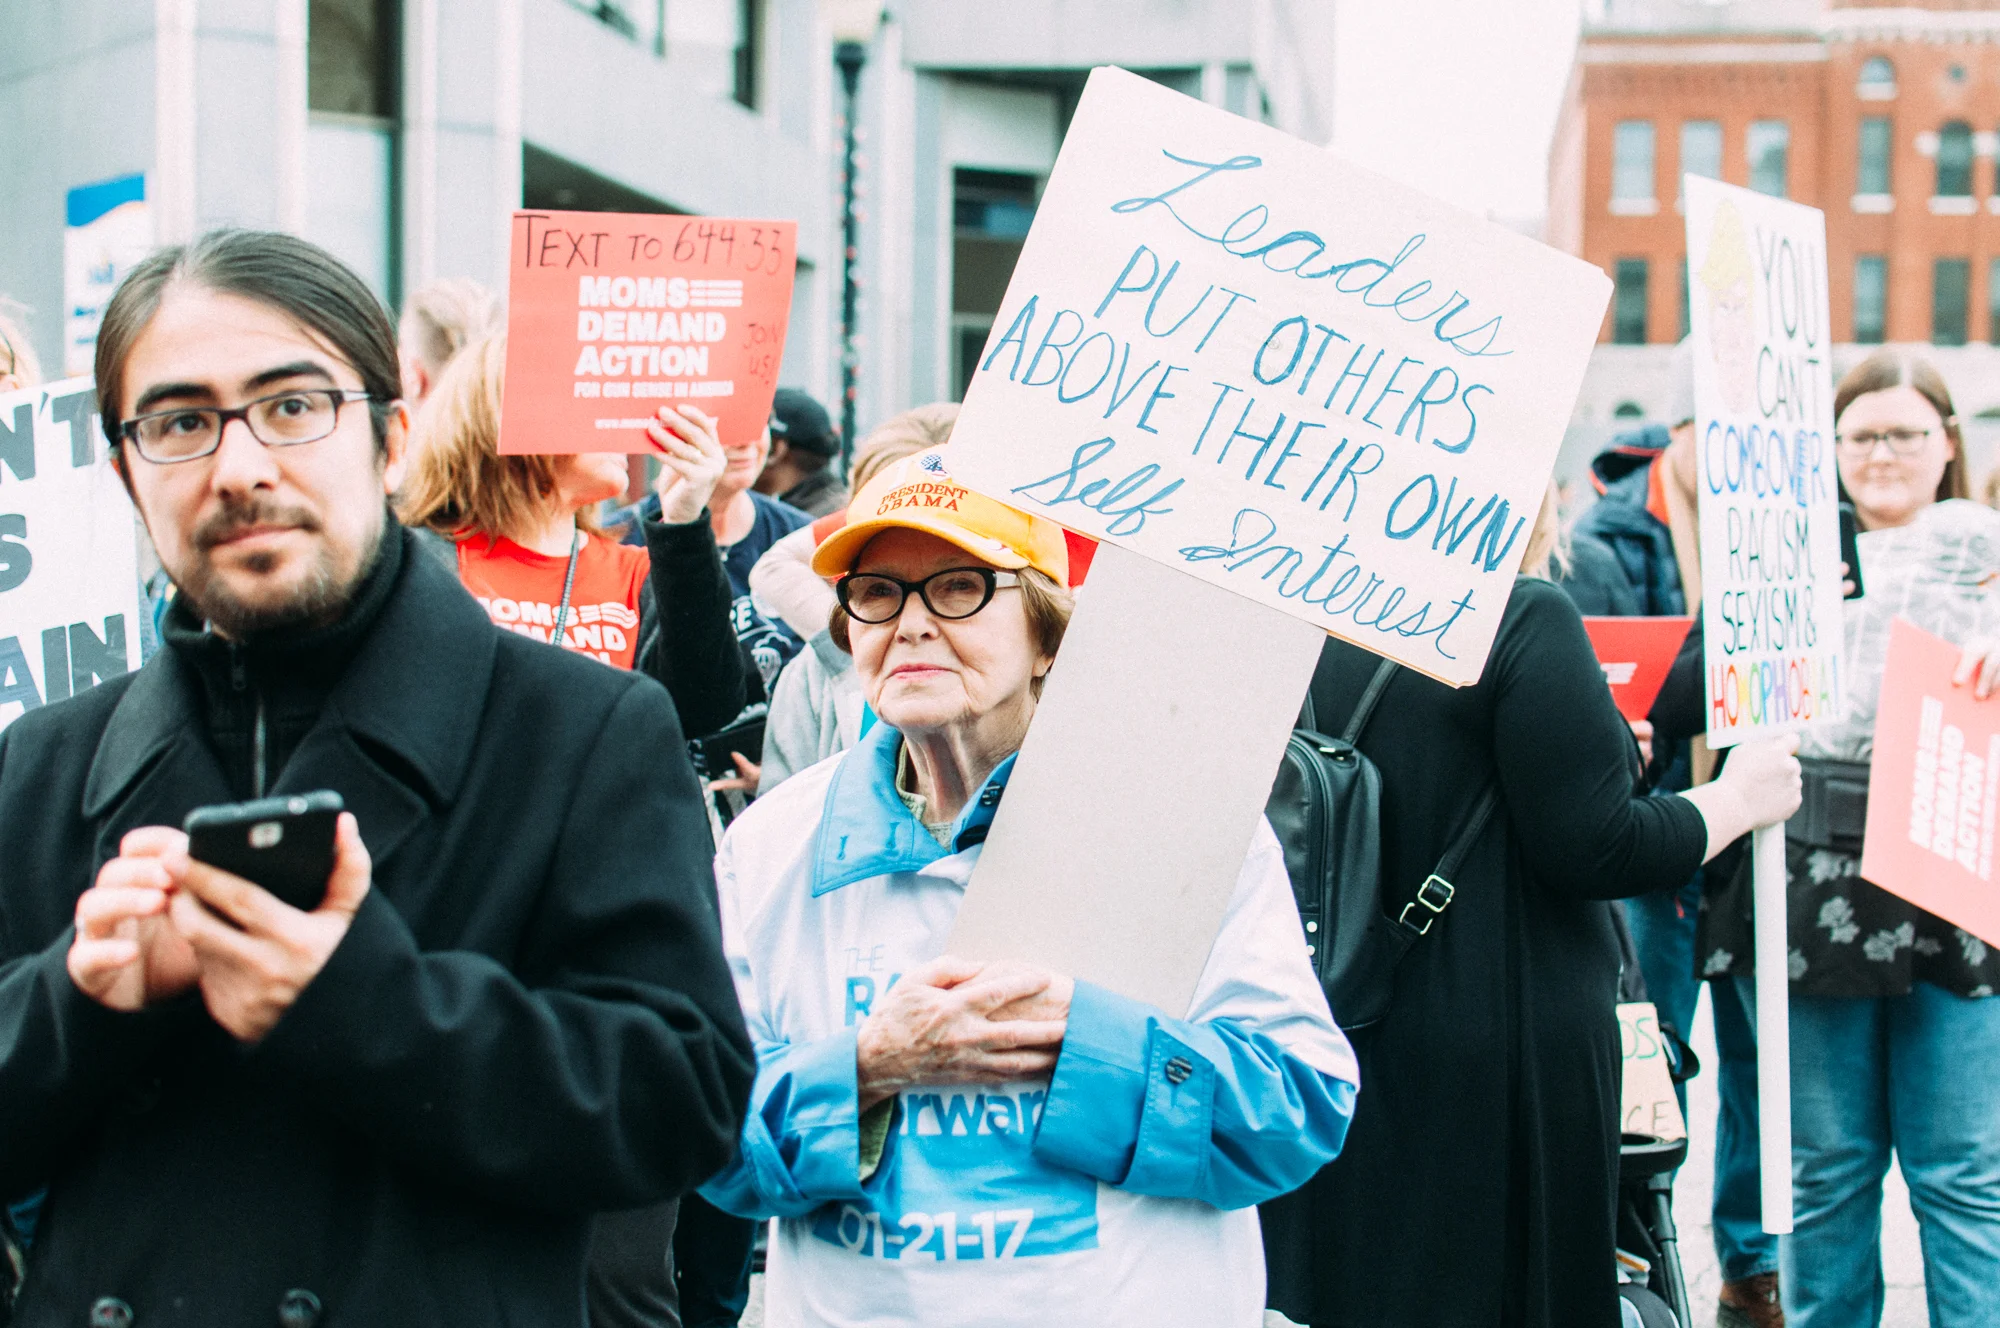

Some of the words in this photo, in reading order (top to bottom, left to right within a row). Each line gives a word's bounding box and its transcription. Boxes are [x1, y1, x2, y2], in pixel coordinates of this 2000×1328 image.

[513, 214, 610, 269] TEXT
[628, 234, 662, 261] TO
[1110, 148, 1514, 355] Leaders
[578, 275, 690, 308] MOMS
[1755, 225, 1819, 349] YOU
[577, 310, 727, 342] DEMAND
[1093, 244, 1256, 353] PUT
[1252, 314, 1495, 453] OTHERS
[574, 345, 709, 377] ACTION
[981, 294, 1190, 434] ABOVE
[1191, 380, 1384, 522] THEIR
[1384, 473, 1527, 574] OWN
[876, 494, 960, 516] OBAMA
[880, 482, 969, 506] PRESIDENT
[1010, 437, 1186, 537] Self
[1177, 507, 1476, 660] Interest
[1721, 587, 1800, 656] SEXISM
[1803, 584, 1817, 648] &
[844, 943, 885, 972] THE
[837, 1203, 1035, 1262] 01-21-17
